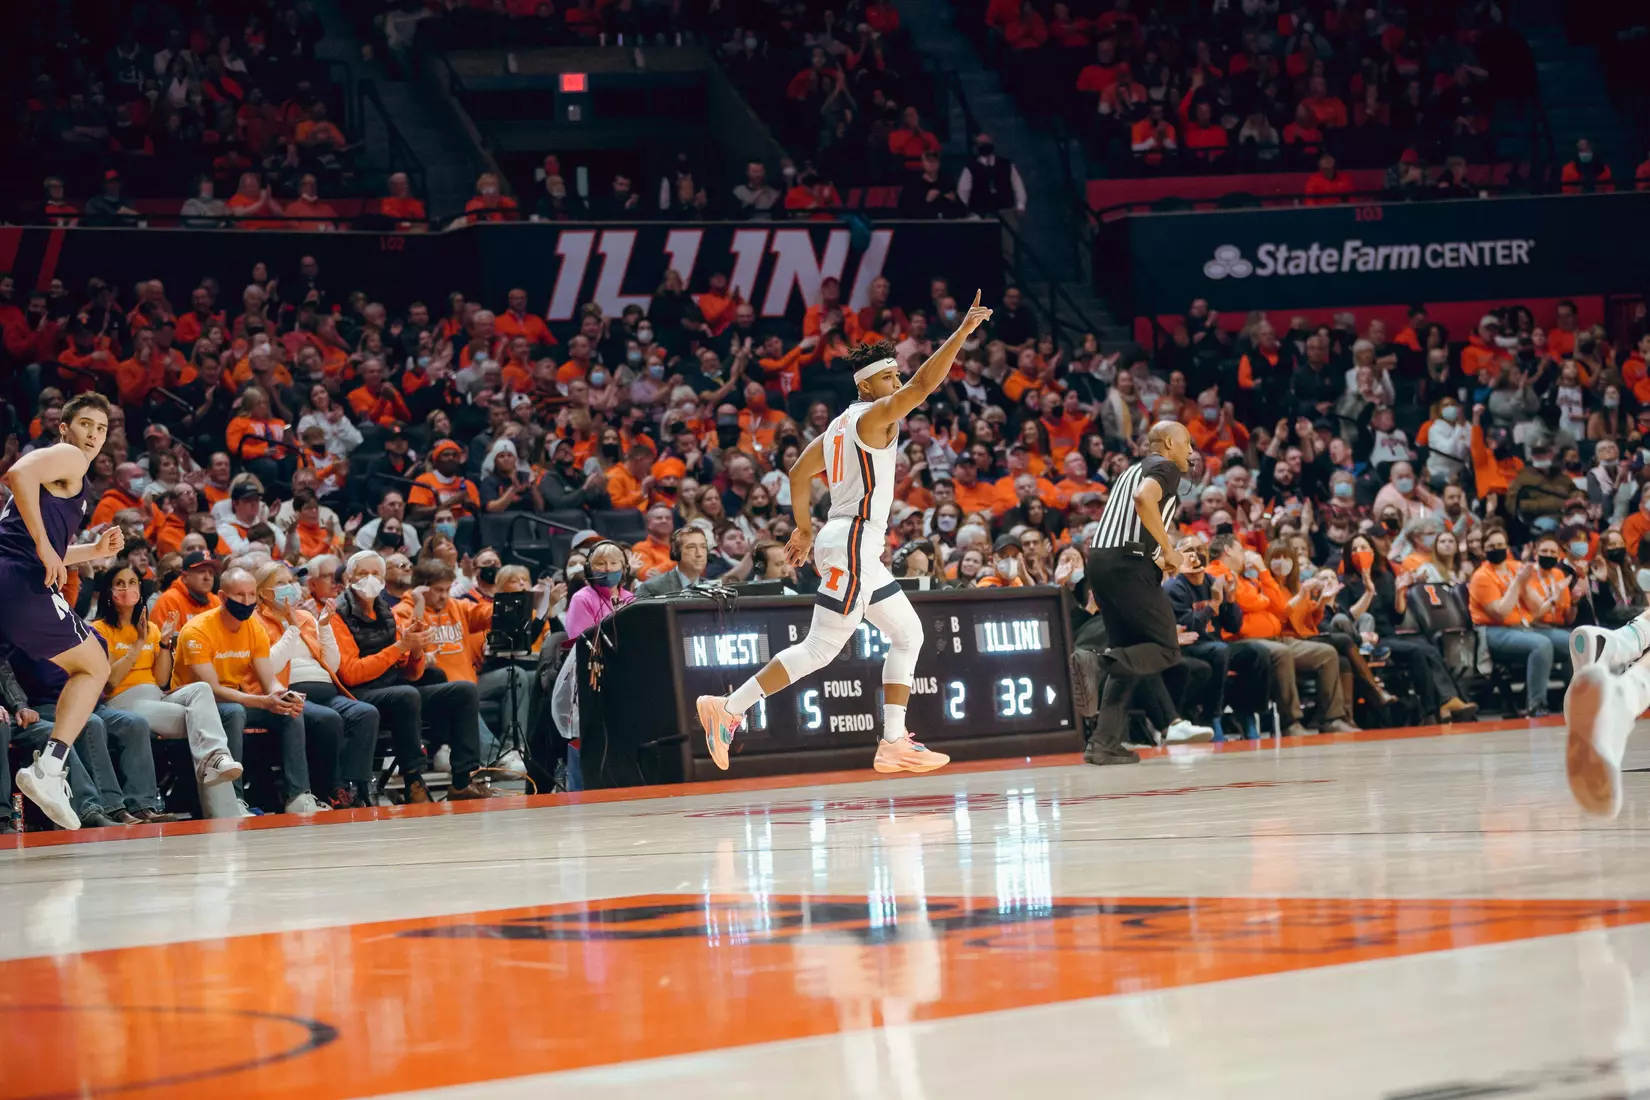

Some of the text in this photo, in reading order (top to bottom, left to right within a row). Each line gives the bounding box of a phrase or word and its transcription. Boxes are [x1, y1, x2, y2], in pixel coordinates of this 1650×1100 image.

[1355, 205, 1383, 222] 103
[1424, 239, 1530, 269] CENTER
[788, 624, 798, 642] B
[950, 616, 960, 633] B
[952, 637, 963, 653] B
[984, 620, 1042, 652] ILLINI
[693, 633, 759, 667] N WEST
[823, 680, 862, 698] FOULS
[909, 677, 938, 695] OULS
[950, 681, 966, 719] 2
[1000, 677, 1033, 716] 32
[803, 690, 822, 729] 5
[829, 713, 874, 733] PERIOD
